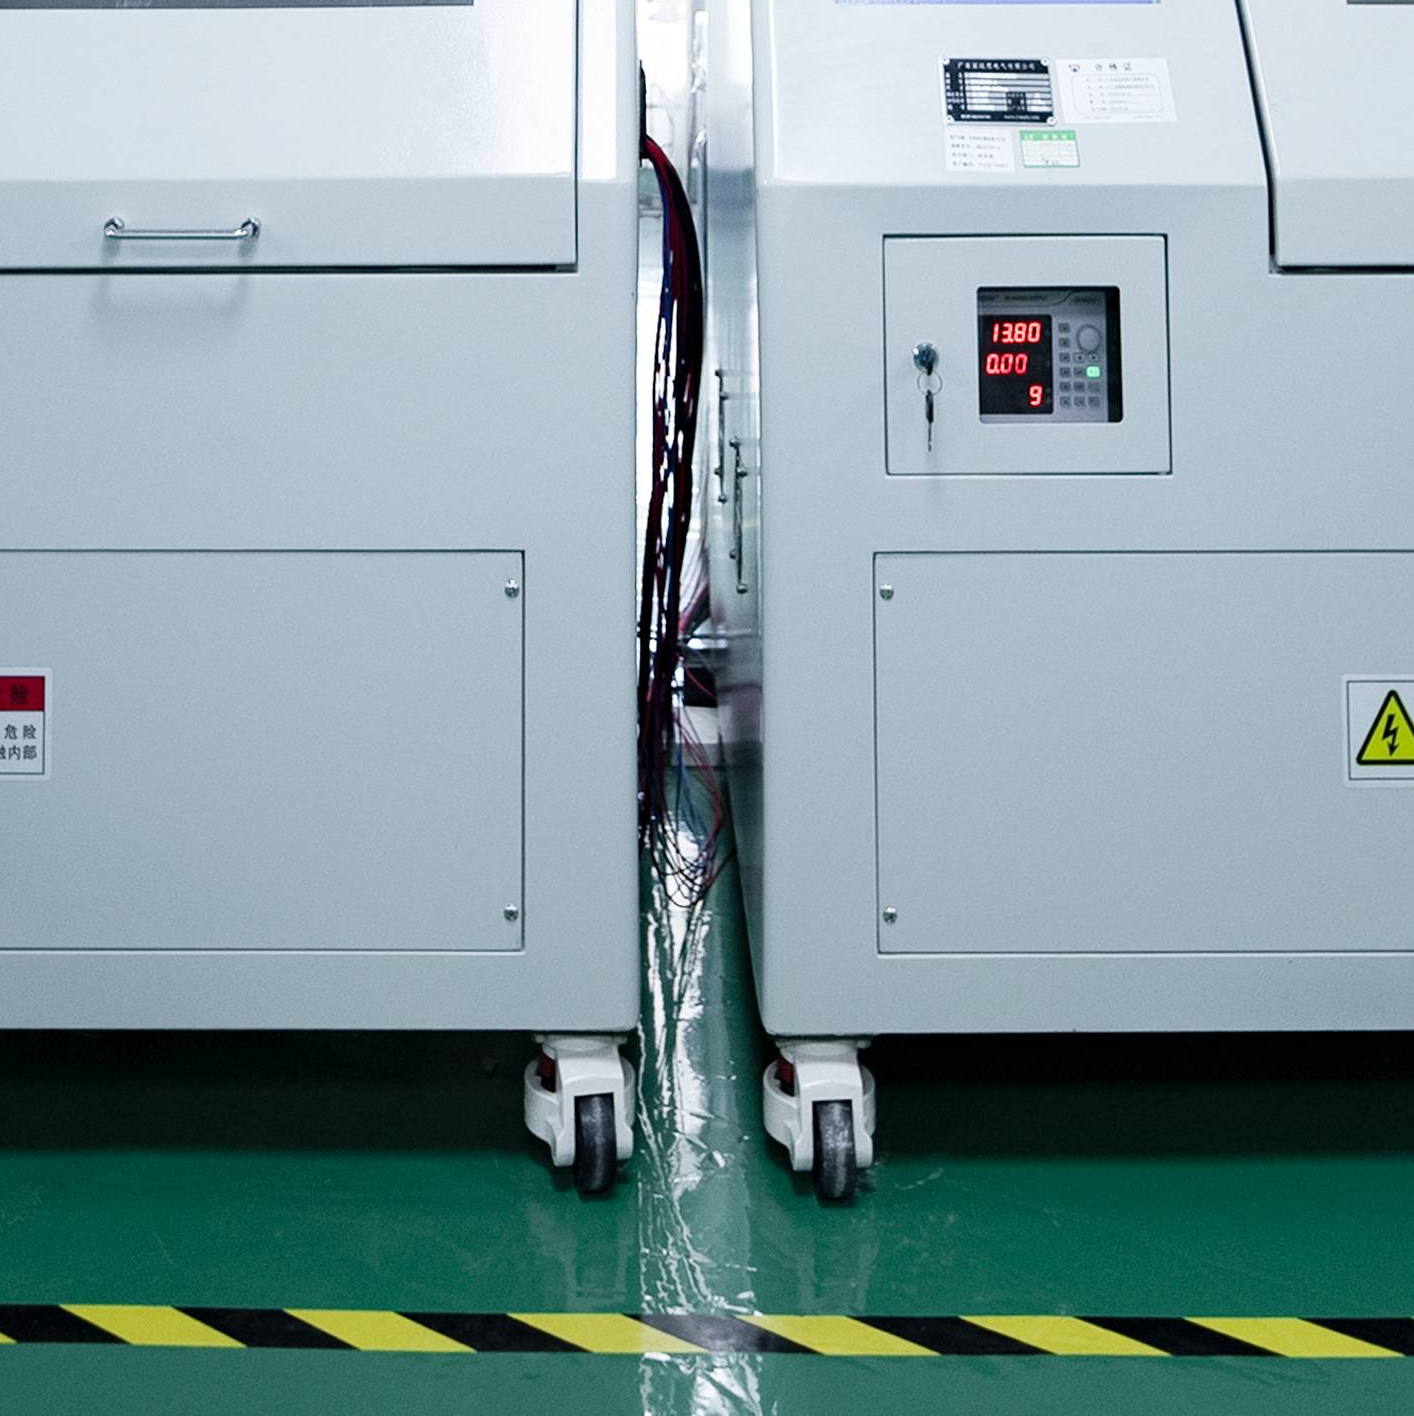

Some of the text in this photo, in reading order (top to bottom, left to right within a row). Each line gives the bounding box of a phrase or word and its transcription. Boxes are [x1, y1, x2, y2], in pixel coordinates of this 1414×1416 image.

[992, 322, 1042, 343] 13.80
[986, 353, 1028, 374] 0.00
[1028, 385, 1043, 406] 9
